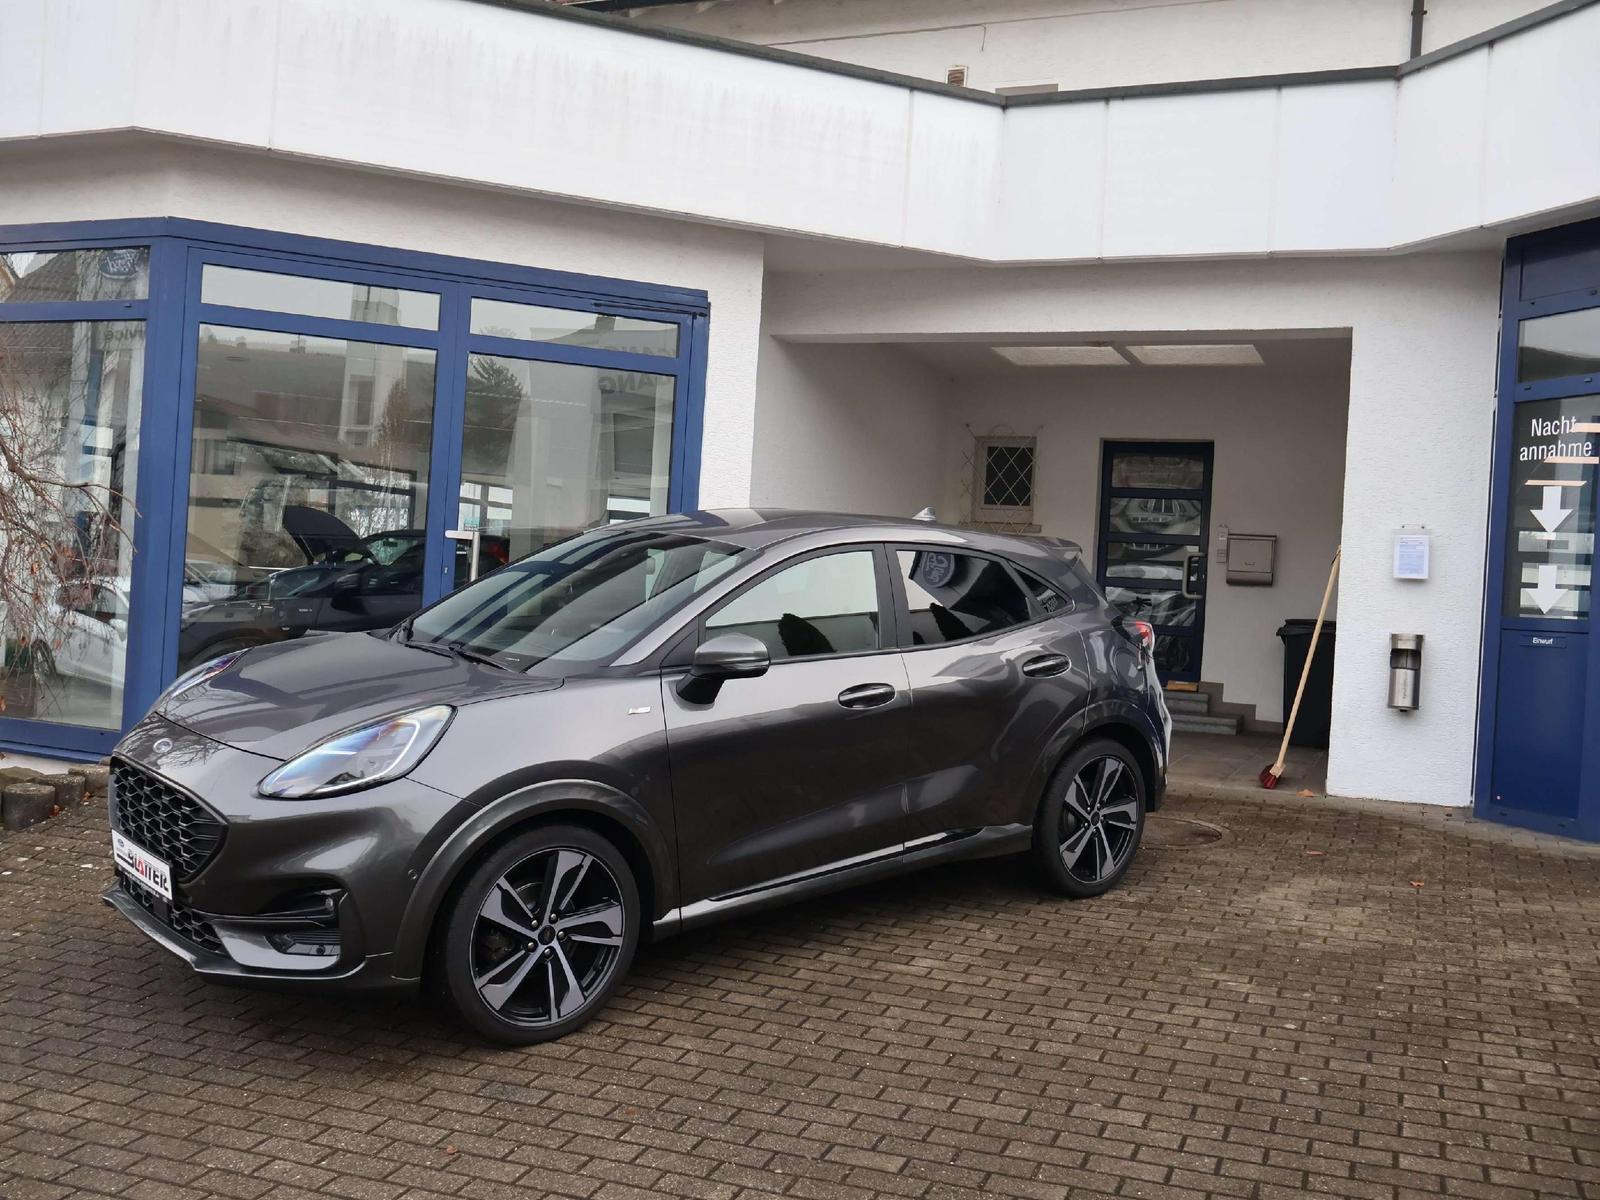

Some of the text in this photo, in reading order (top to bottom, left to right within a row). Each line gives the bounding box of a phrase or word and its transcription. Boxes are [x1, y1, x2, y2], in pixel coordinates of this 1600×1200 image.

[1531, 415, 1577, 437] Nacht
[1519, 440, 1593, 462] annahme
[1532, 636, 1554, 645] Einwurf
